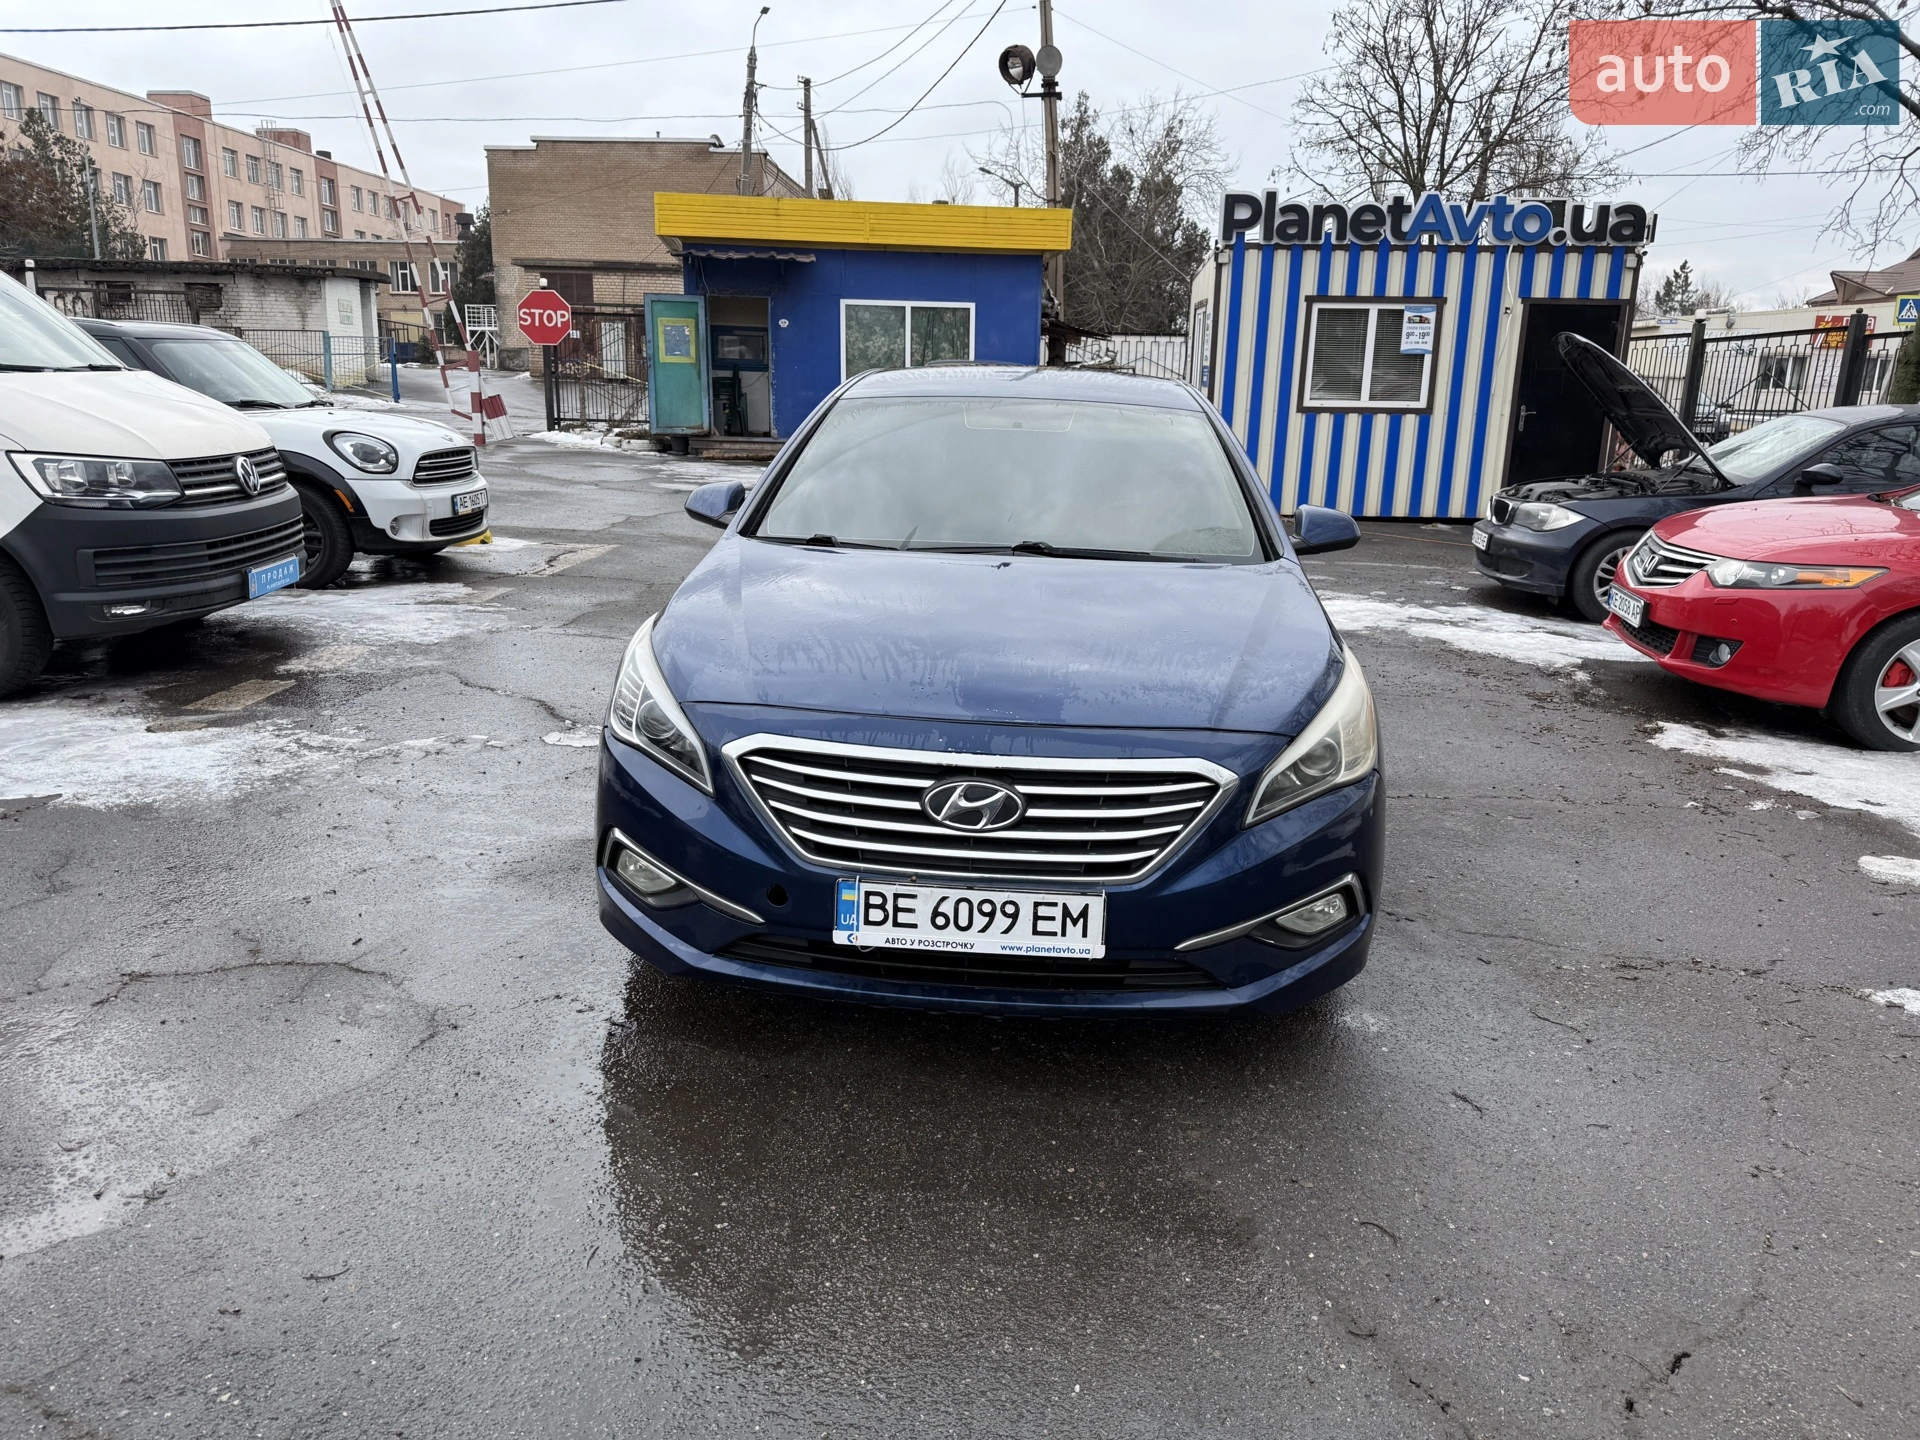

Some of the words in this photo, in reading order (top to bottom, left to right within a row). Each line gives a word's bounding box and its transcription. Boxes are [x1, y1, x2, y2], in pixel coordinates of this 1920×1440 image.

[1222, 189, 1649, 244] PlanetAvto.ua
[519, 308, 569, 328] STOP
[459, 496, 469, 509] AE
[261, 564, 294, 584] ПРОДАЖ
[863, 890, 919, 930] BE
[930, 896, 1021, 935] 6099
[1031, 901, 1090, 939] EM
[884, 937, 908, 946] АВТО
[909, 939, 916, 947] У
[917, 940, 975, 950] РОЗСТРОЧКУ
[1000, 944, 1091, 955] www.planetavto.ua
